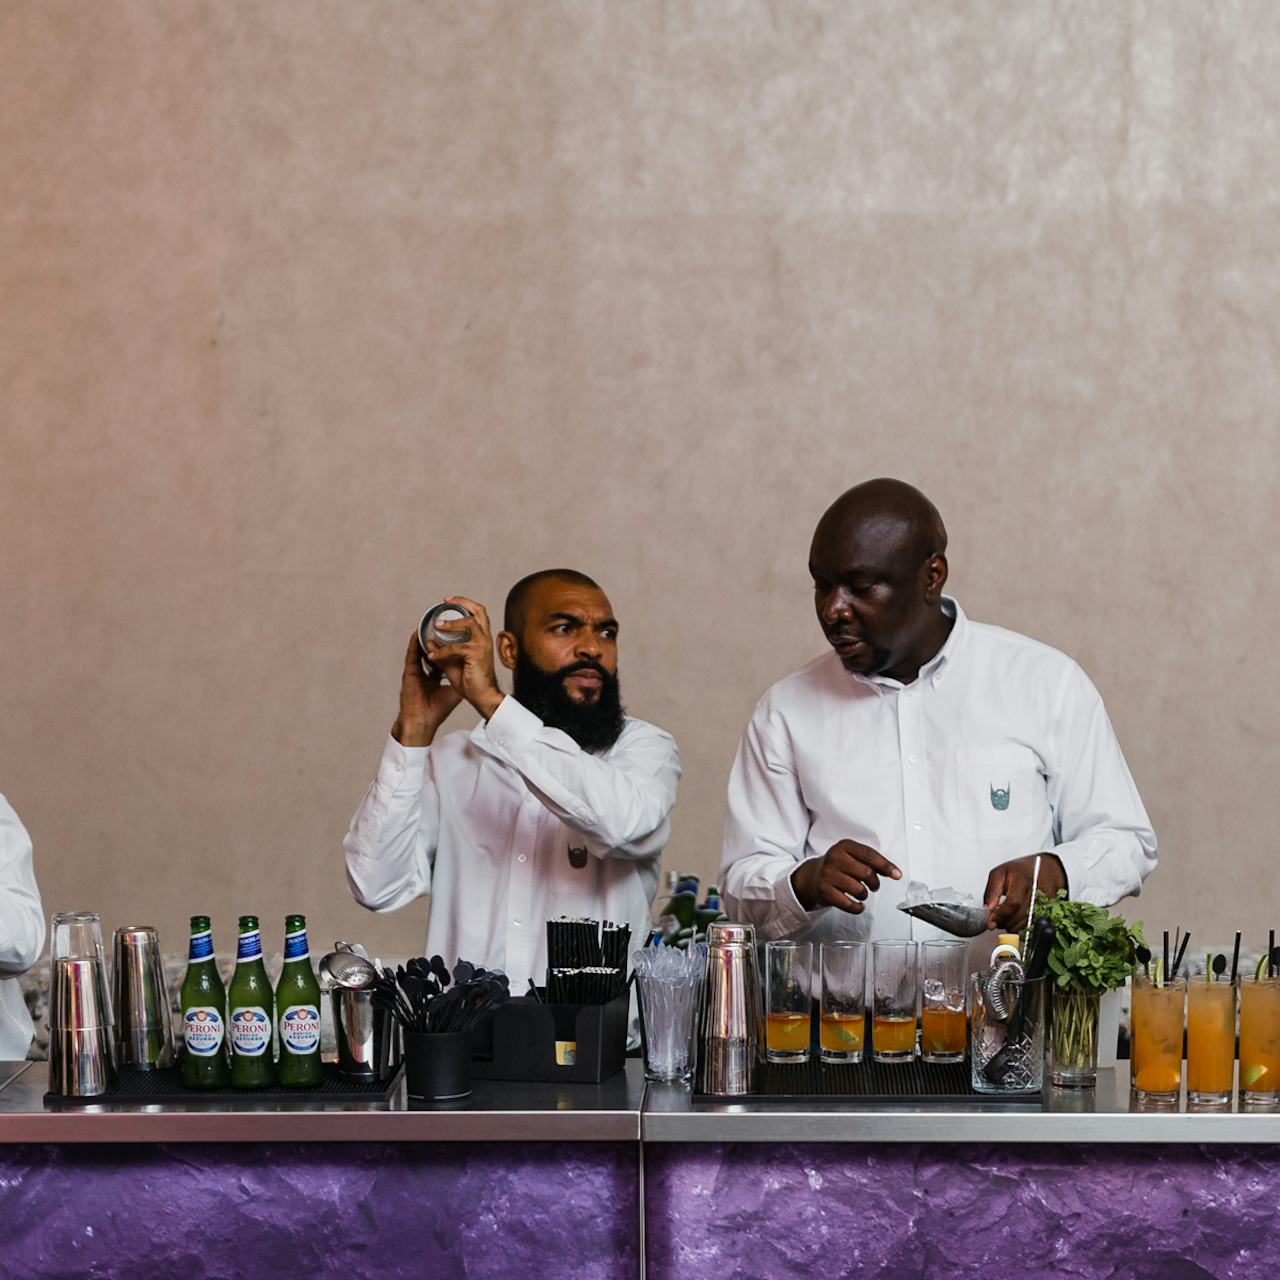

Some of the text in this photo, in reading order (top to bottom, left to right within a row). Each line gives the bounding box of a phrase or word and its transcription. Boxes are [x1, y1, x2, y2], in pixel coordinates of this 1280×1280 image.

[185, 1024, 221, 1033] PERONI
[232, 1024, 268, 1033] PERONI
[284, 1022, 320, 1031] PERONI
